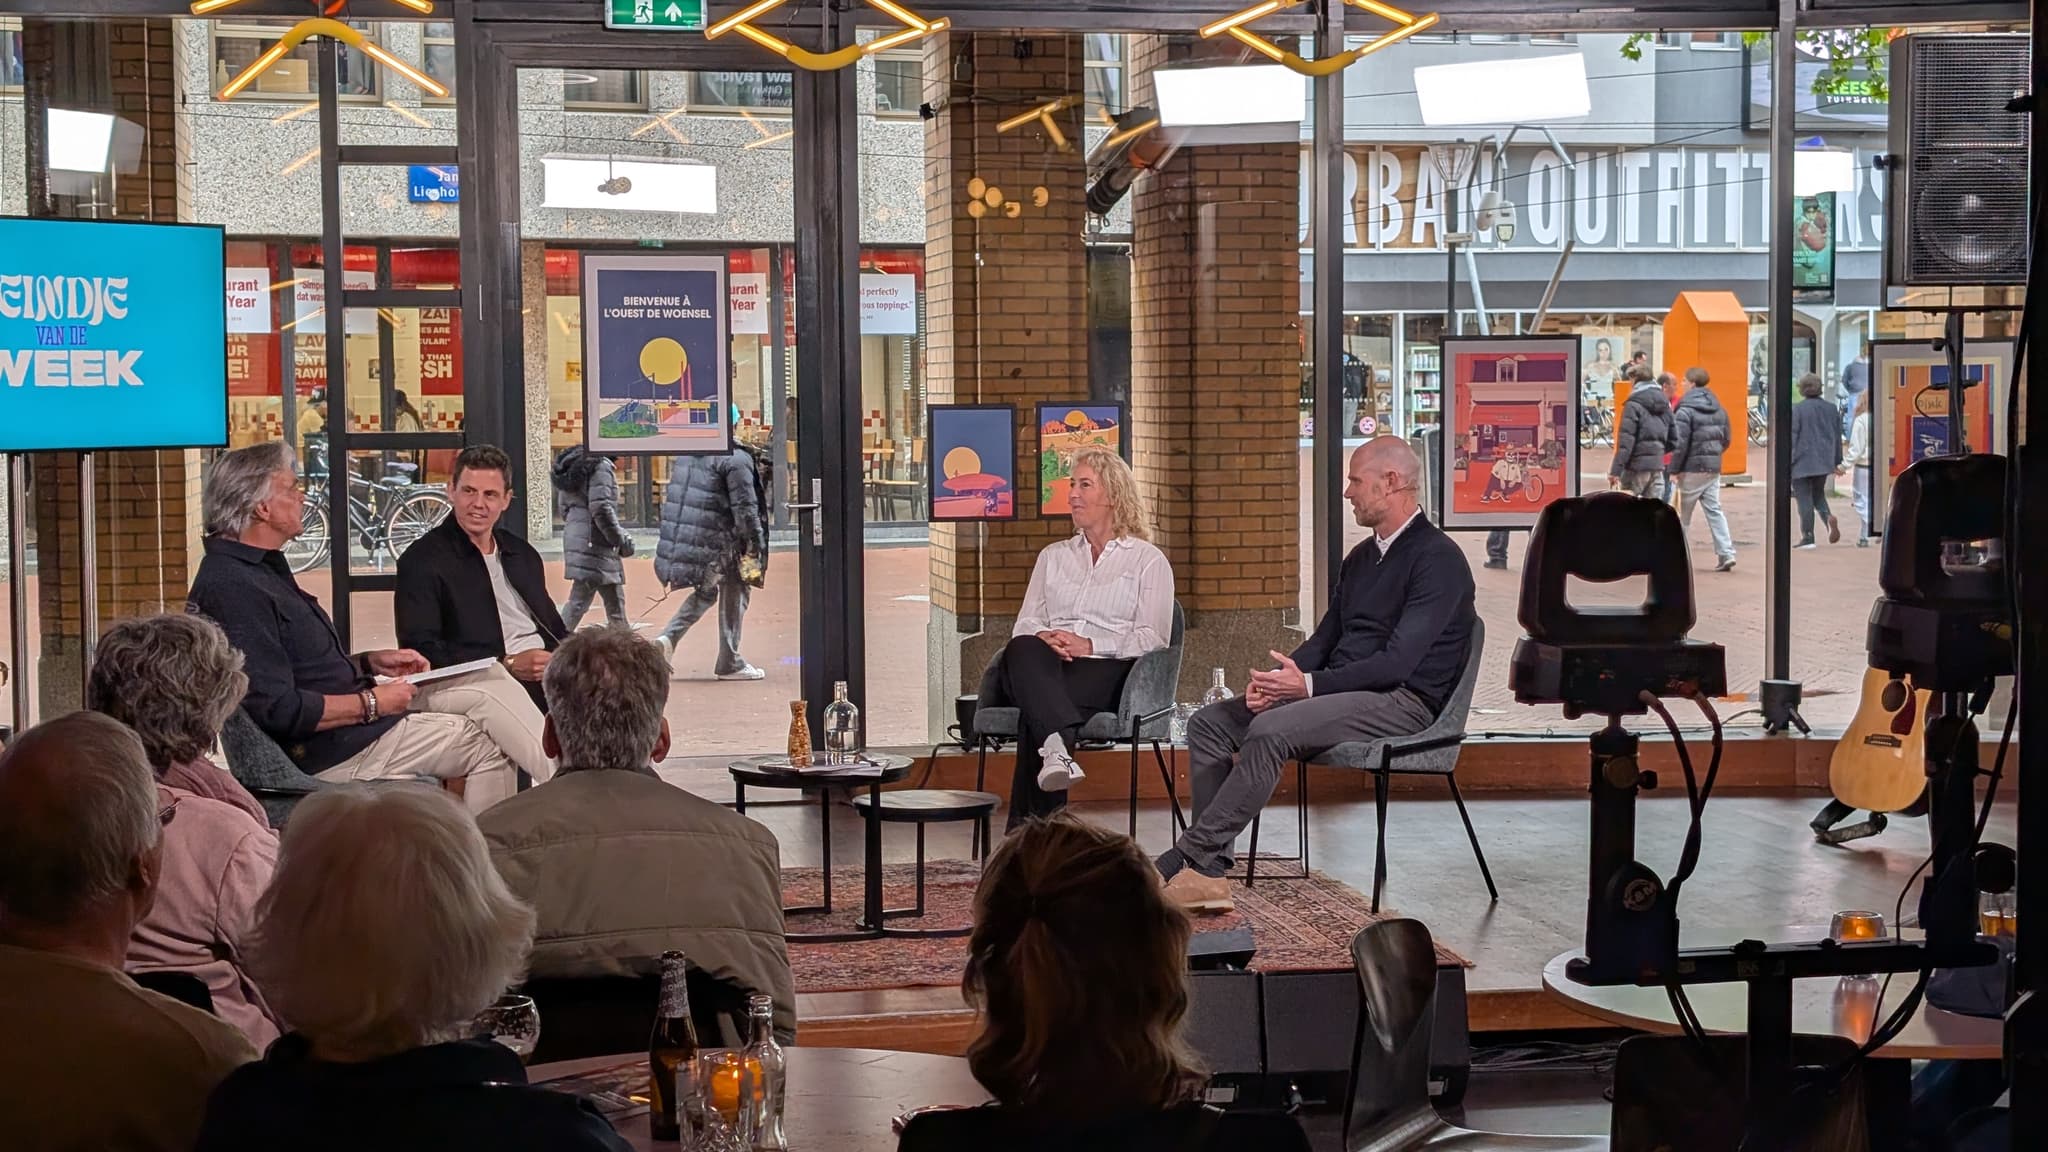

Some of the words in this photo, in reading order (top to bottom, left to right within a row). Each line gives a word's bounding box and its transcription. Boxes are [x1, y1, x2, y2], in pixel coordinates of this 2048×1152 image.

[1527, 149, 1884, 245] OUTFITTR
[866, 287, 899, 297] perfectly
[228, 296, 257, 308] Year
[623, 296, 681, 306] BIENVENUE
[682, 294, 691, 306] À
[732, 299, 756, 311] Year
[604, 308, 645, 318] L'OUEST
[647, 309, 660, 318] DE
[663, 308, 712, 319] WOENSEL
[35, 326, 65, 346] VAN
[69, 326, 88, 346] DE
[433, 326, 450, 334] ARE
[427, 353, 452, 361] THAN
[420, 361, 453, 379] SH
